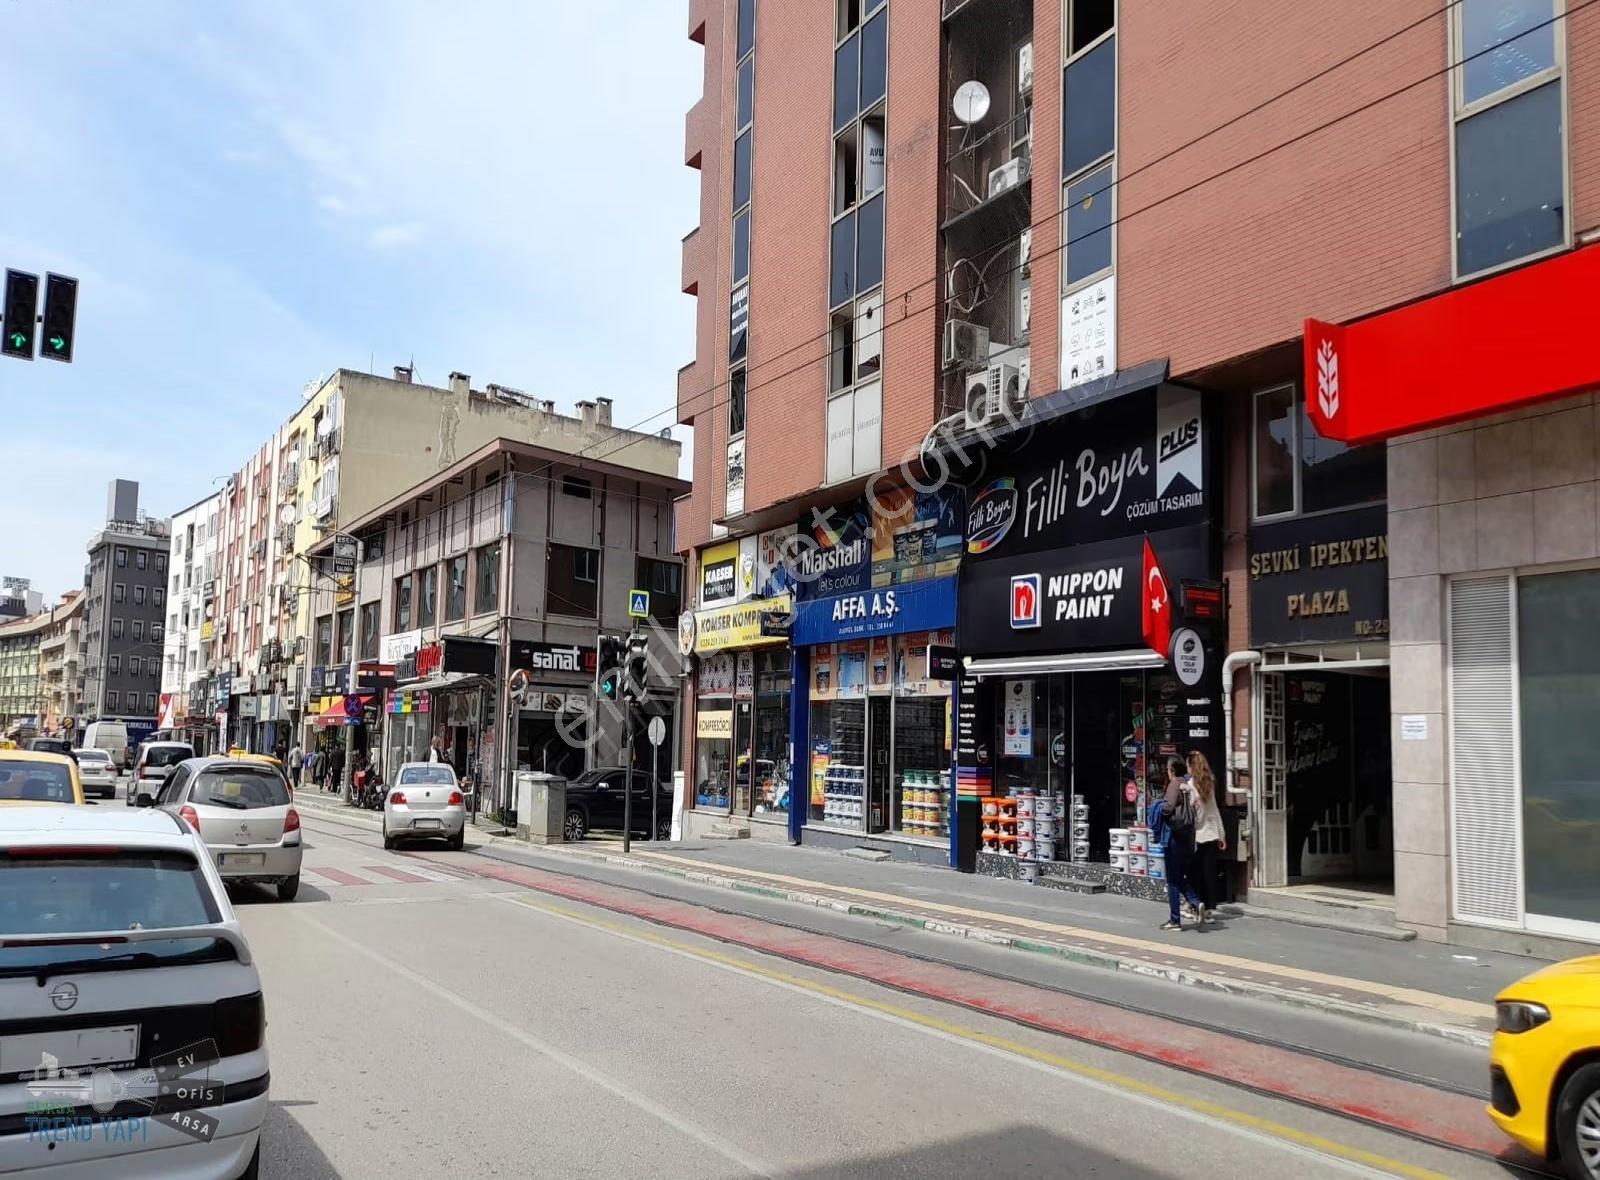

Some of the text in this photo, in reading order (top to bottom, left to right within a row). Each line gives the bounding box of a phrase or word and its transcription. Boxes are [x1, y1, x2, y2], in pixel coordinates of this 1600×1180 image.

[1160, 418, 1199, 456] PLUS
[1025, 448, 1150, 538] Filli Boya
[1126, 491, 1203, 521] ÇÖZÜM TASARIM
[967, 500, 1011, 535] Filli Boya
[802, 539, 863, 575] Marshall
[1251, 544, 1300, 580] ŞEVKİ
[705, 565, 734, 584] KAESER
[835, 574, 861, 589] colour
[1048, 567, 1123, 597] NIPPON
[832, 590, 900, 621] AFFA A.Ş.
[1055, 594, 1114, 621] PAINT
[1287, 589, 1350, 617] PLAZA
[701, 613, 731, 633] KOMSER
[533, 647, 580, 671] sanat
